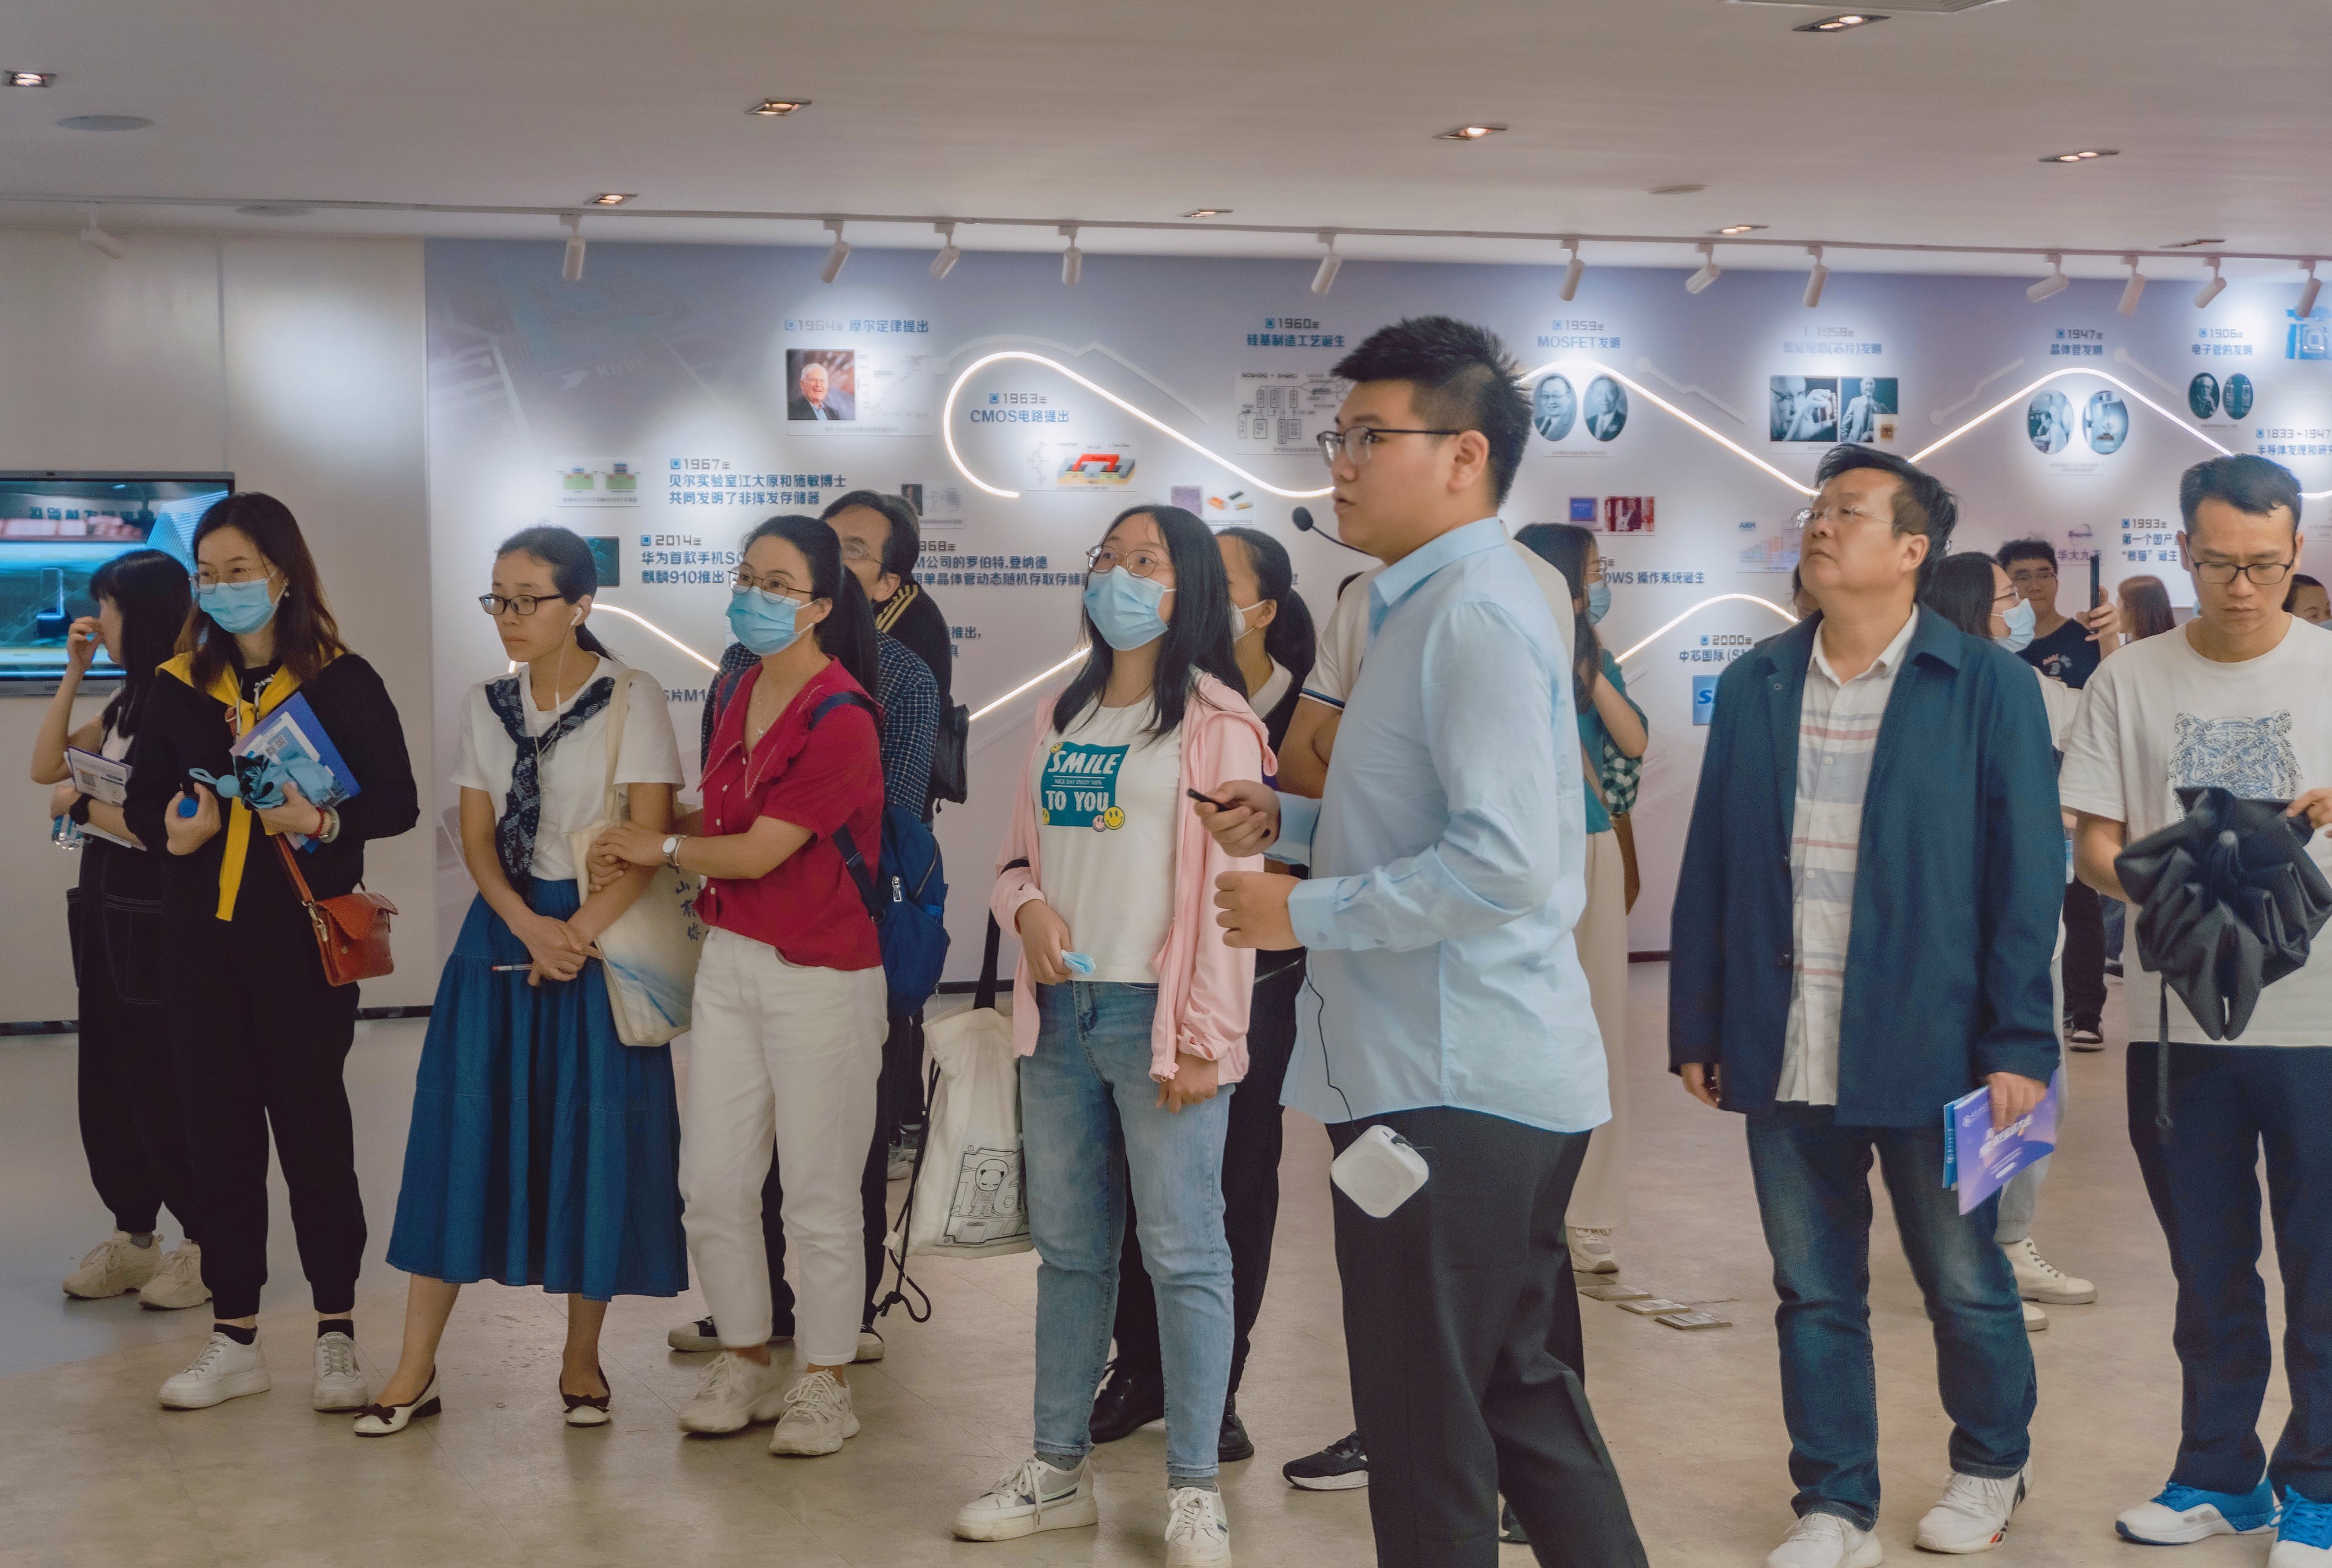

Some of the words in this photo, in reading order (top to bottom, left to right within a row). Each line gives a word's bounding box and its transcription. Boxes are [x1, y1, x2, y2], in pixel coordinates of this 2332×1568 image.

[849, 319, 929, 333] 摩尔定律提出
[1278, 318, 1320, 329] 1960年
[1565, 320, 1605, 331] 1959年
[2067, 329, 2103, 340] 1947年
[2209, 328, 2243, 338] 1906年
[1247, 334, 1346, 347] 硅基制造工艺诞生
[1537, 335, 1621, 349] MOSFET发明
[2050, 343, 2103, 356] 晶体管发明
[2191, 344, 2253, 355] 电子管的发明
[1003, 392, 1047, 404] 1963年
[970, 409, 1069, 423] CMOS电路提出
[2257, 443, 2332, 456] 半导体发现和研
[683, 458, 730, 470] 1967年
[669, 473, 847, 488] 贝尔实验室江大原和施敏博士
[669, 491, 820, 506] 共同发明了非挥发存储器
[2132, 519, 2167, 529] 1993年
[655, 534, 702, 547] 2014年
[641, 569, 725, 585] 麒麟910推出
[1637, 571, 1705, 584] 操作系统诞生
[1712, 634, 1753, 645] 2000年
[1679, 648, 1745, 662] 中芯国际(S
[1048, 750, 1121, 774] SMILE
[1045, 790, 1067, 810] TO
[1073, 791, 1110, 812] YOU
